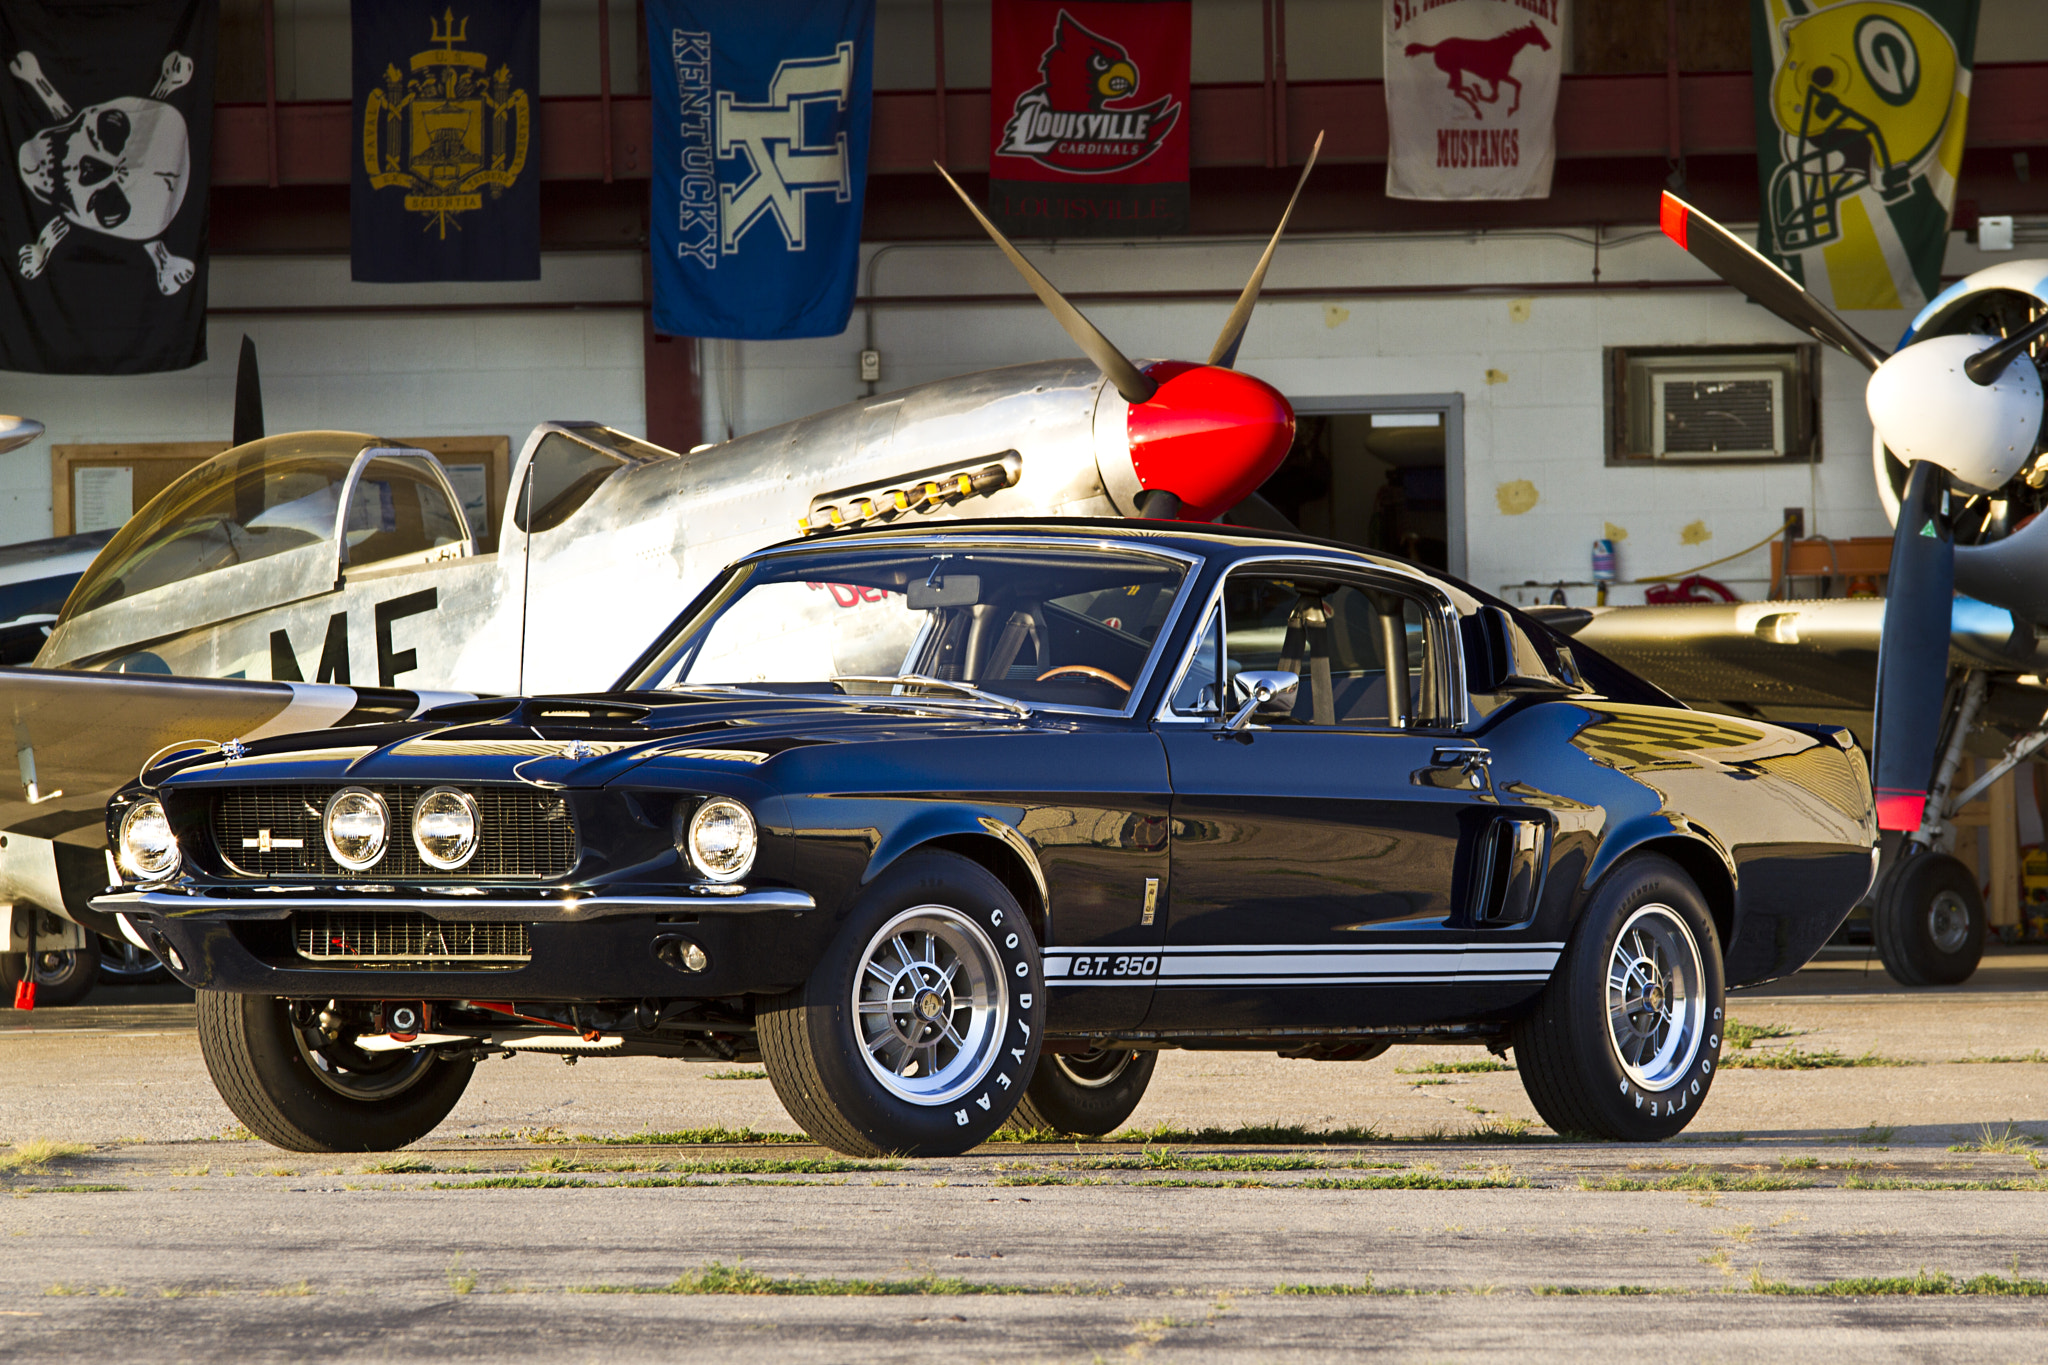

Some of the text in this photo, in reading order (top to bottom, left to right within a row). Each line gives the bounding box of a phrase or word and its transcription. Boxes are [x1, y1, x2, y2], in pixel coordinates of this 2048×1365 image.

[367, 109, 377, 163] NAVAL
[673, 29, 716, 269] KENTUCKY
[716, 41, 854, 253] UK
[1003, 92, 1152, 153] LOUISVILLE
[1058, 143, 1139, 156] CARDINALS
[1437, 128, 1519, 168] MUSTANGS
[411, 196, 477, 208] SCIENTIA
[1073, 956, 1159, 976] G.T. 350
[954, 908, 1033, 1127] GOODYEAR
[1619, 1006, 1723, 1117] GOODYEAR
